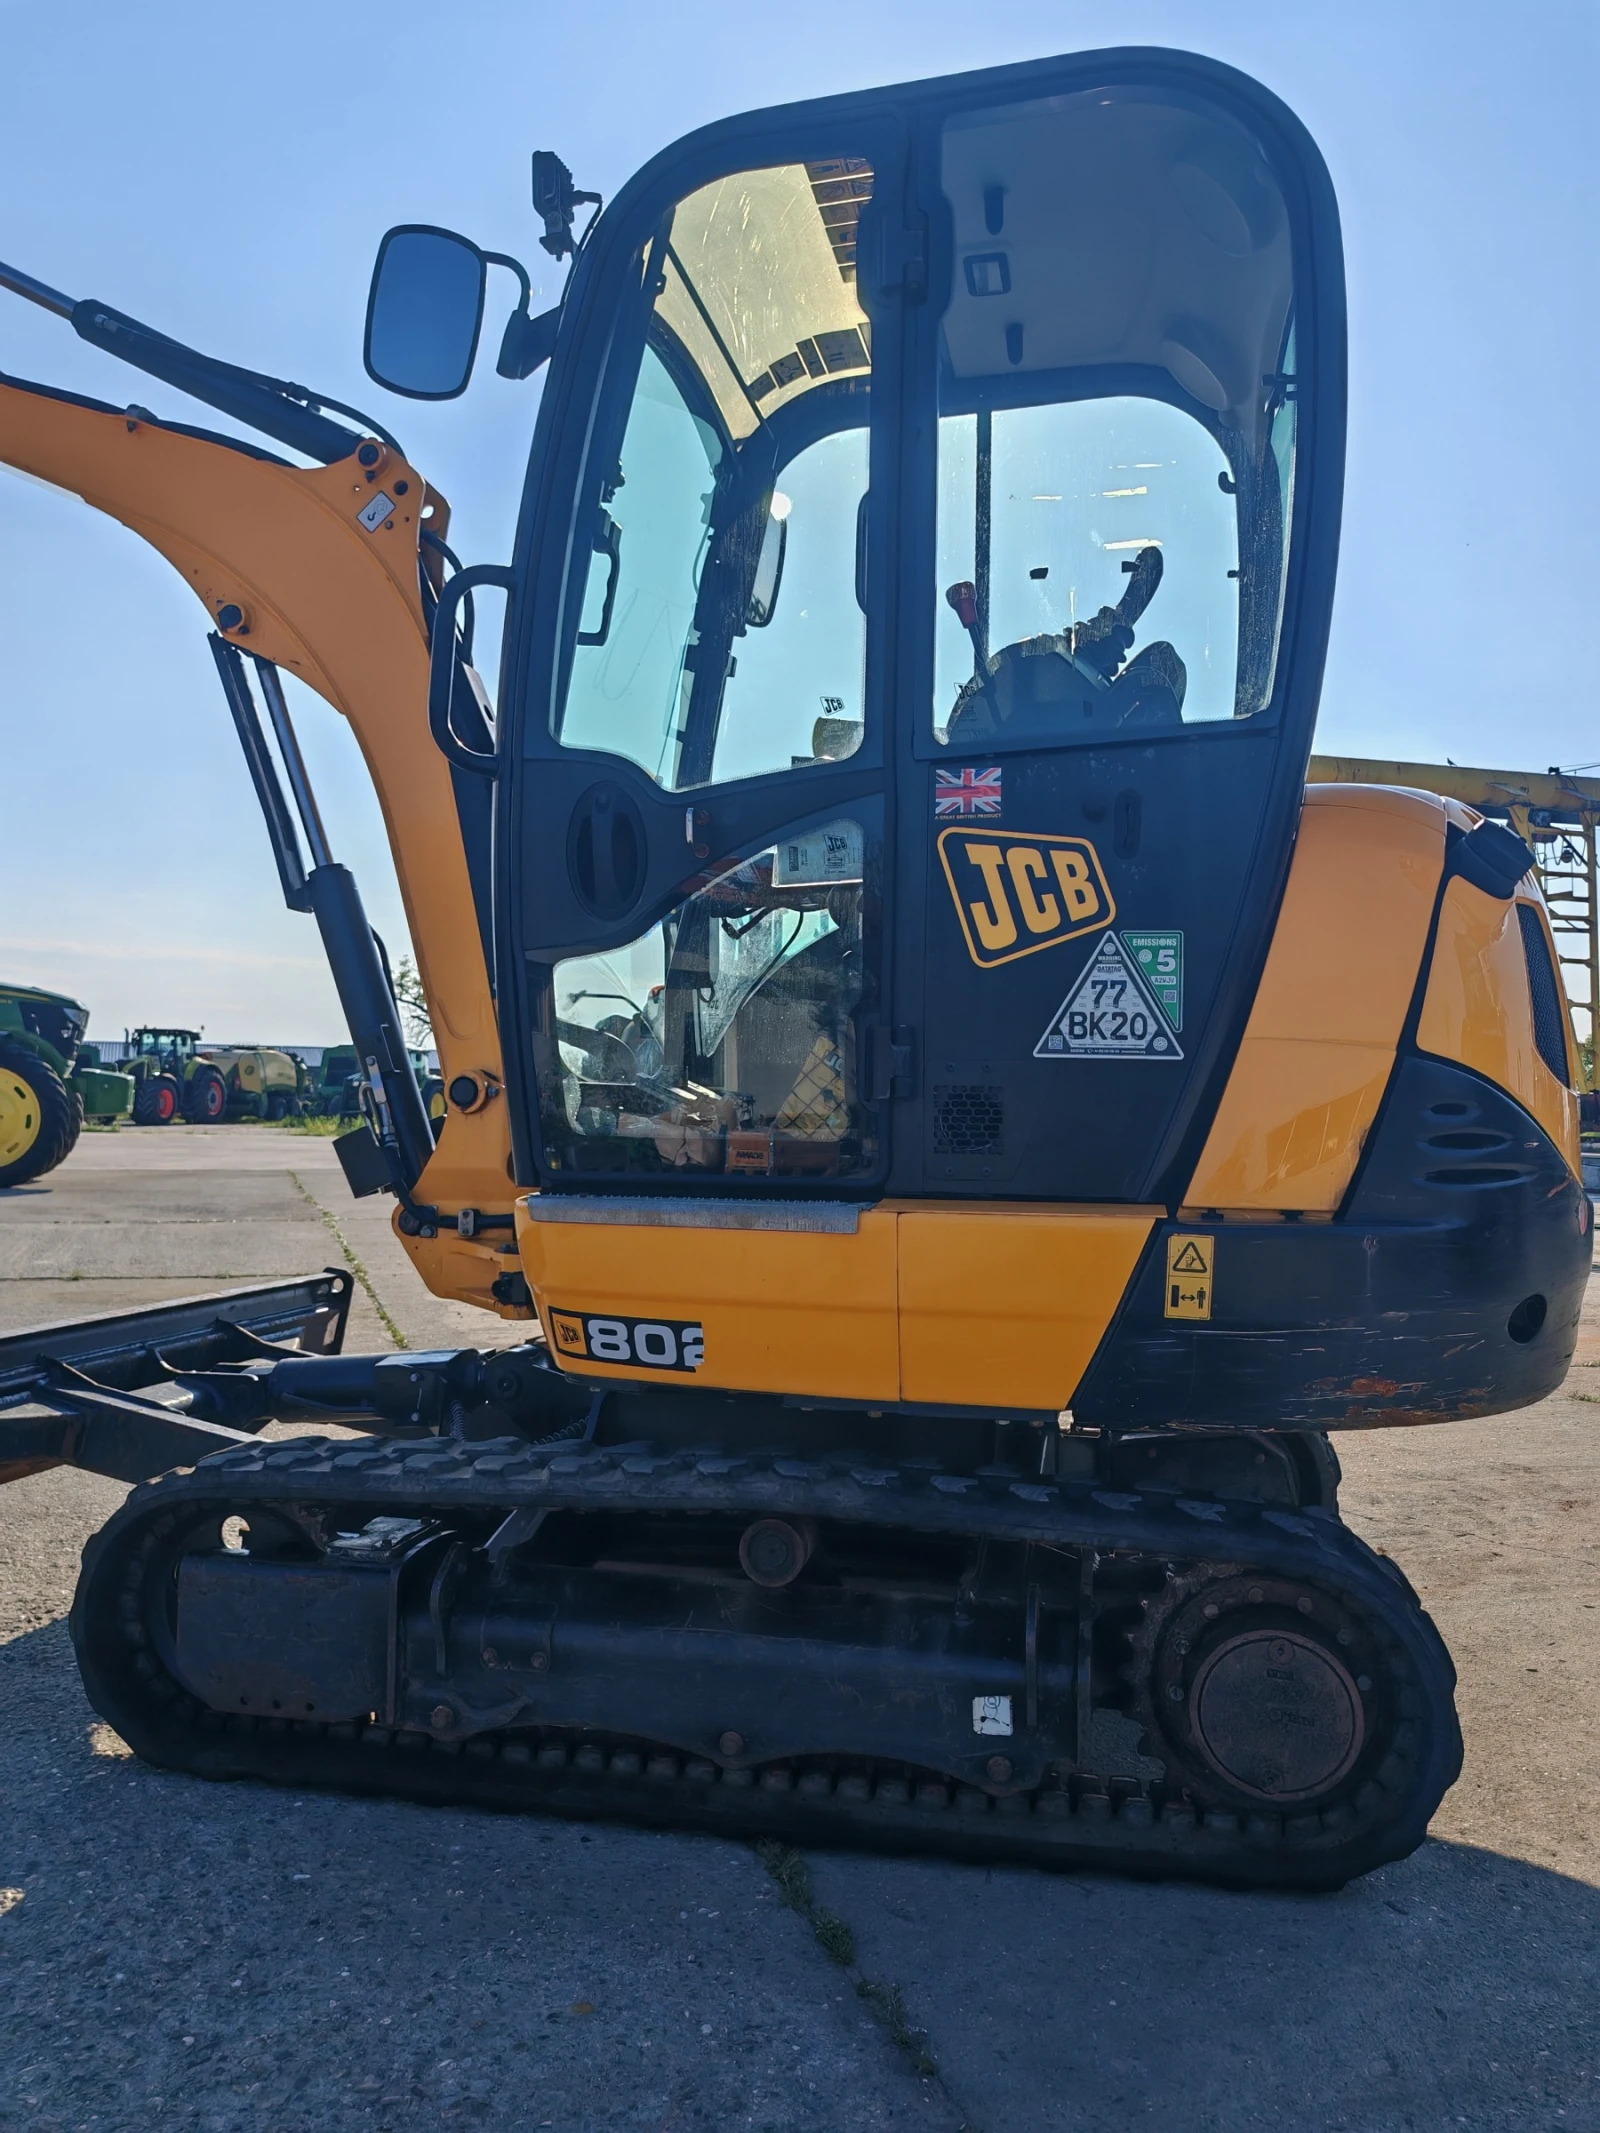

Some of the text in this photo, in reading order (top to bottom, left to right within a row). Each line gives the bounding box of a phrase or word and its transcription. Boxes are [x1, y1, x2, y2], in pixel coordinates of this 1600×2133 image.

[824, 699, 843, 714] JCB
[828, 837, 846, 852] JCB
[965, 843, 1100, 950] JCB
[1132, 938, 1177, 947] EMISSIONS
[1156, 949, 1176, 972] 5
[1091, 979, 1128, 1009] 77
[1068, 1011, 1148, 1041] BK20
[560, 1324, 580, 1343] JCB
